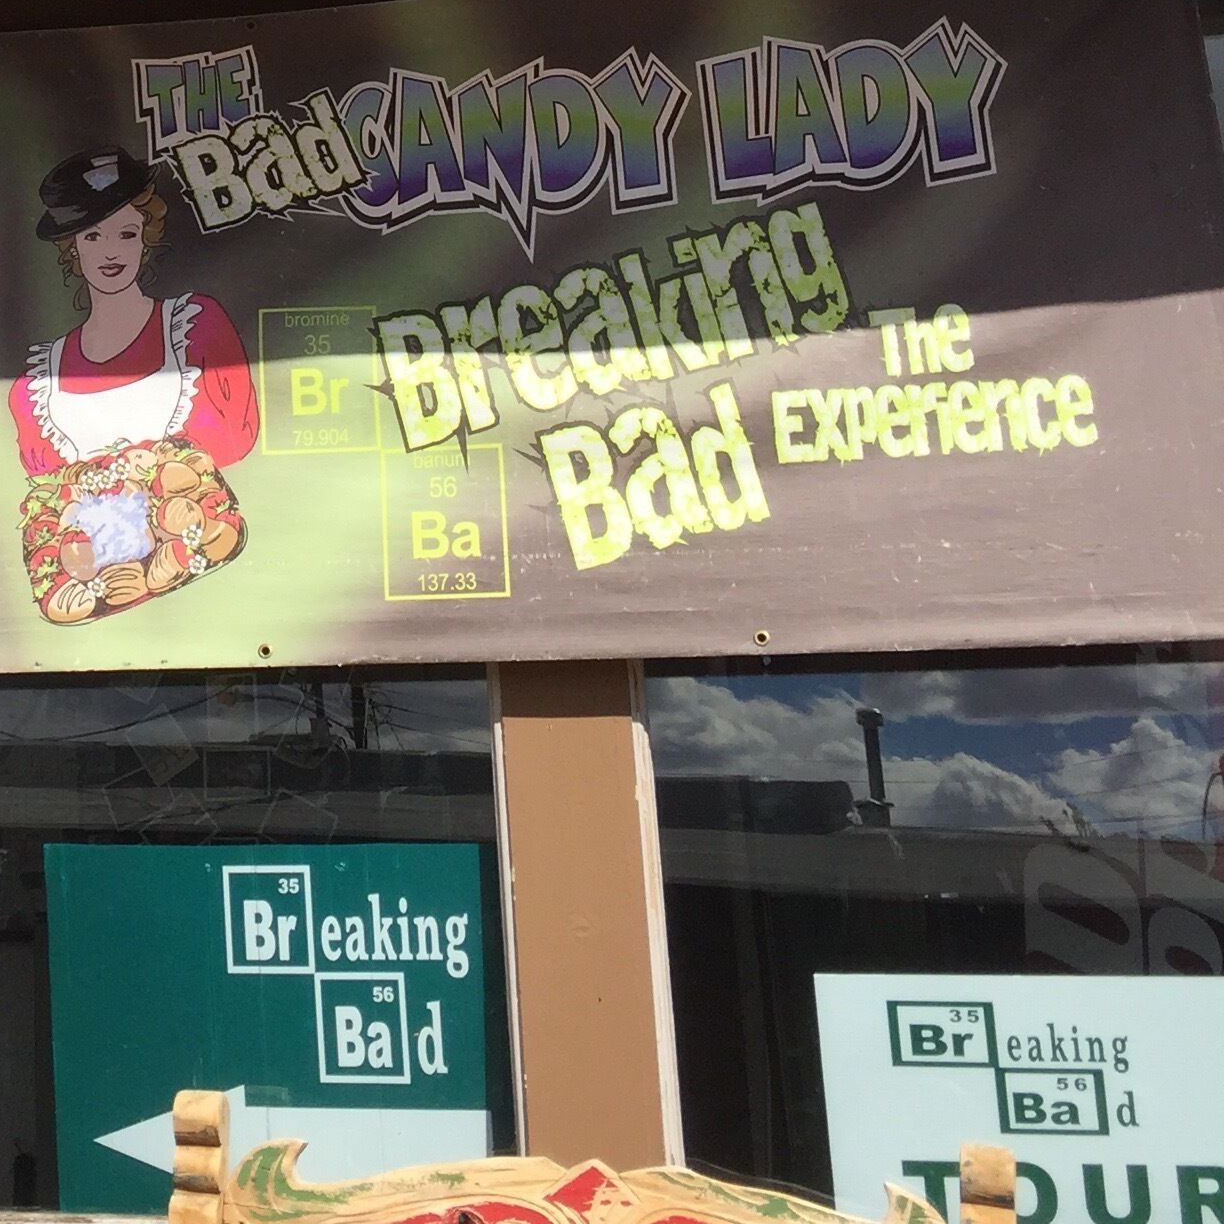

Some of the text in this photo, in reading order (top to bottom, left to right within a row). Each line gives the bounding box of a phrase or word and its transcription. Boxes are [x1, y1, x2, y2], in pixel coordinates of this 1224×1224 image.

[136, 20, 1002, 244] THE CANDY LADY
[172, 90, 374, 232] Bad
[284, 312, 350, 329] bromine
[376, 201, 849, 451] Breaking
[304, 334, 331, 355] 35
[869, 303, 974, 377] The
[290, 367, 350, 417] Br
[429, 476, 458, 499] 56
[541, 384, 770, 570] Bad
[411, 510, 482, 560] Ba
[417, 572, 478, 592] 137.33
[278, 878, 300, 894] 35
[373, 986, 394, 1002] 56
[949, 1009, 980, 1023] 35
[1056, 1078, 1088, 1091] 56
